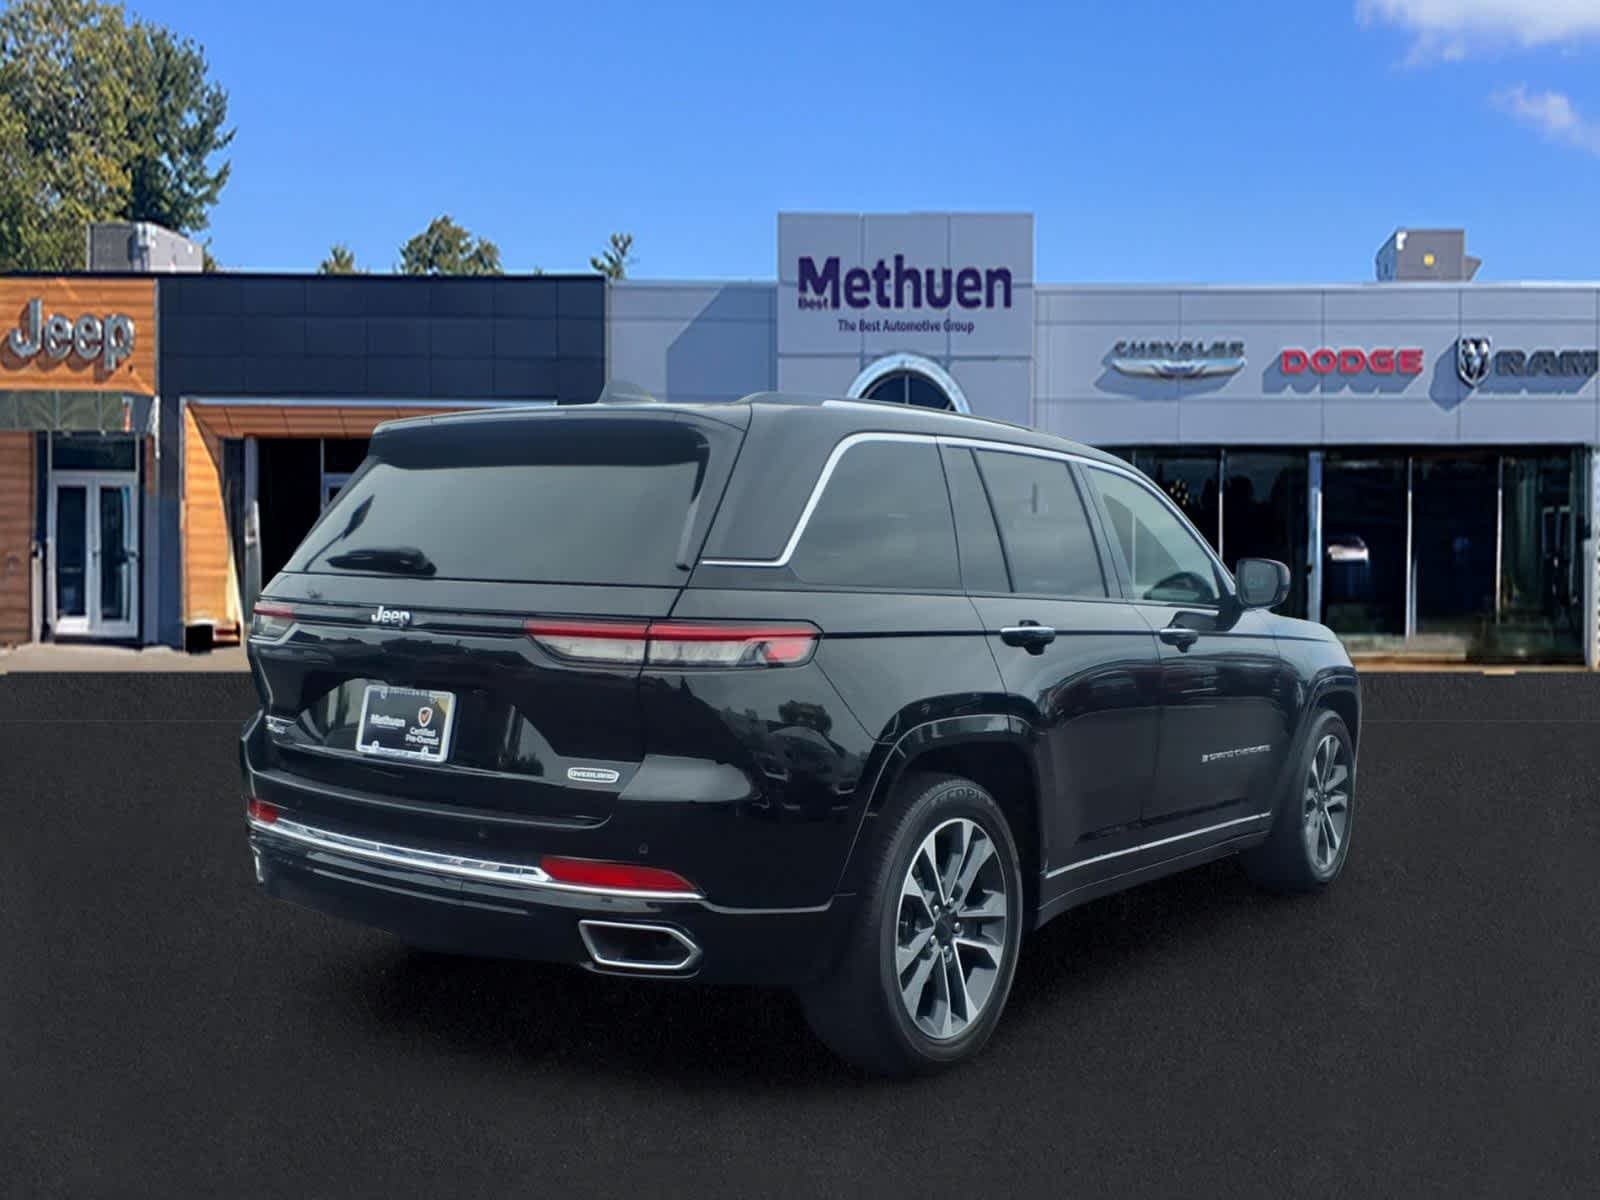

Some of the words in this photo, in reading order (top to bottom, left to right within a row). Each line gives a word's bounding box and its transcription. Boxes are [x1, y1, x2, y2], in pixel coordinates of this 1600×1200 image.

[798, 253, 1012, 310] Methuen
[798, 297, 829, 310] Best
[9, 297, 135, 370] Jeep
[838, 319, 857, 332] The
[859, 319, 881, 332] Best
[882, 319, 941, 332] Automotive
[943, 319, 975, 334] Group
[1113, 340, 1245, 358] CHRYSLER
[1281, 348, 1424, 375] DODGE
[1495, 350, 1599, 376] RAM
[371, 604, 410, 628] Jeep
